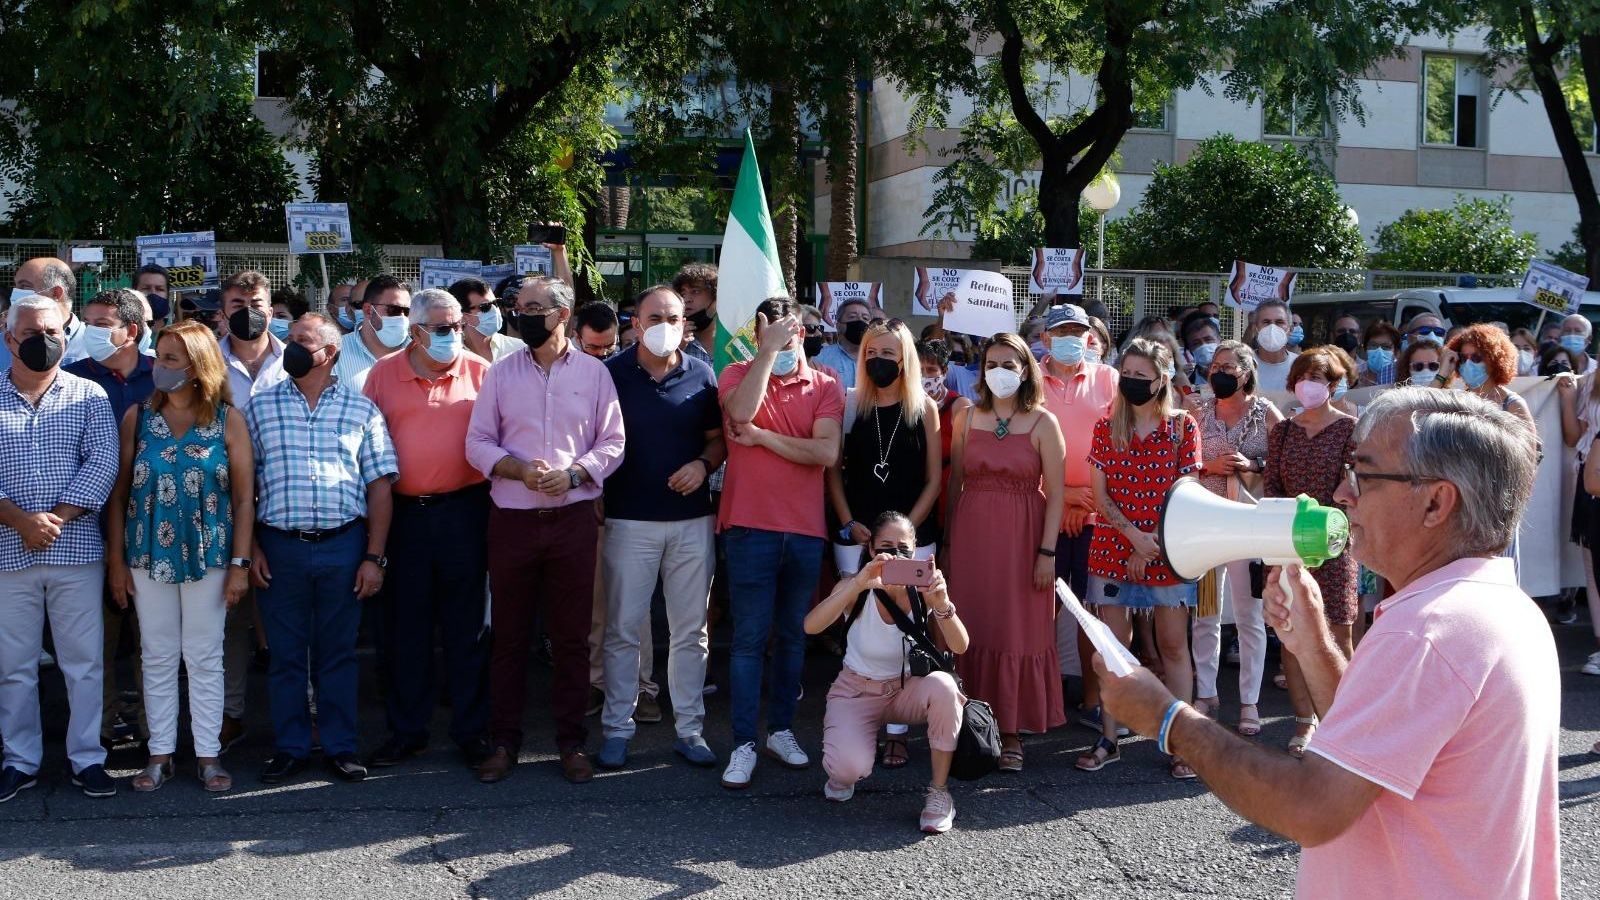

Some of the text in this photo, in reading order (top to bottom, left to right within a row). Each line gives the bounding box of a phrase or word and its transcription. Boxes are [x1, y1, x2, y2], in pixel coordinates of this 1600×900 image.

[310, 235, 336, 246] SOS
[943, 268, 957, 277] NO
[1260, 266, 1274, 276] NO
[1258, 274, 1278, 283] CORTA
[844, 282, 859, 290] NO
[1539, 292, 1565, 307] SOS
